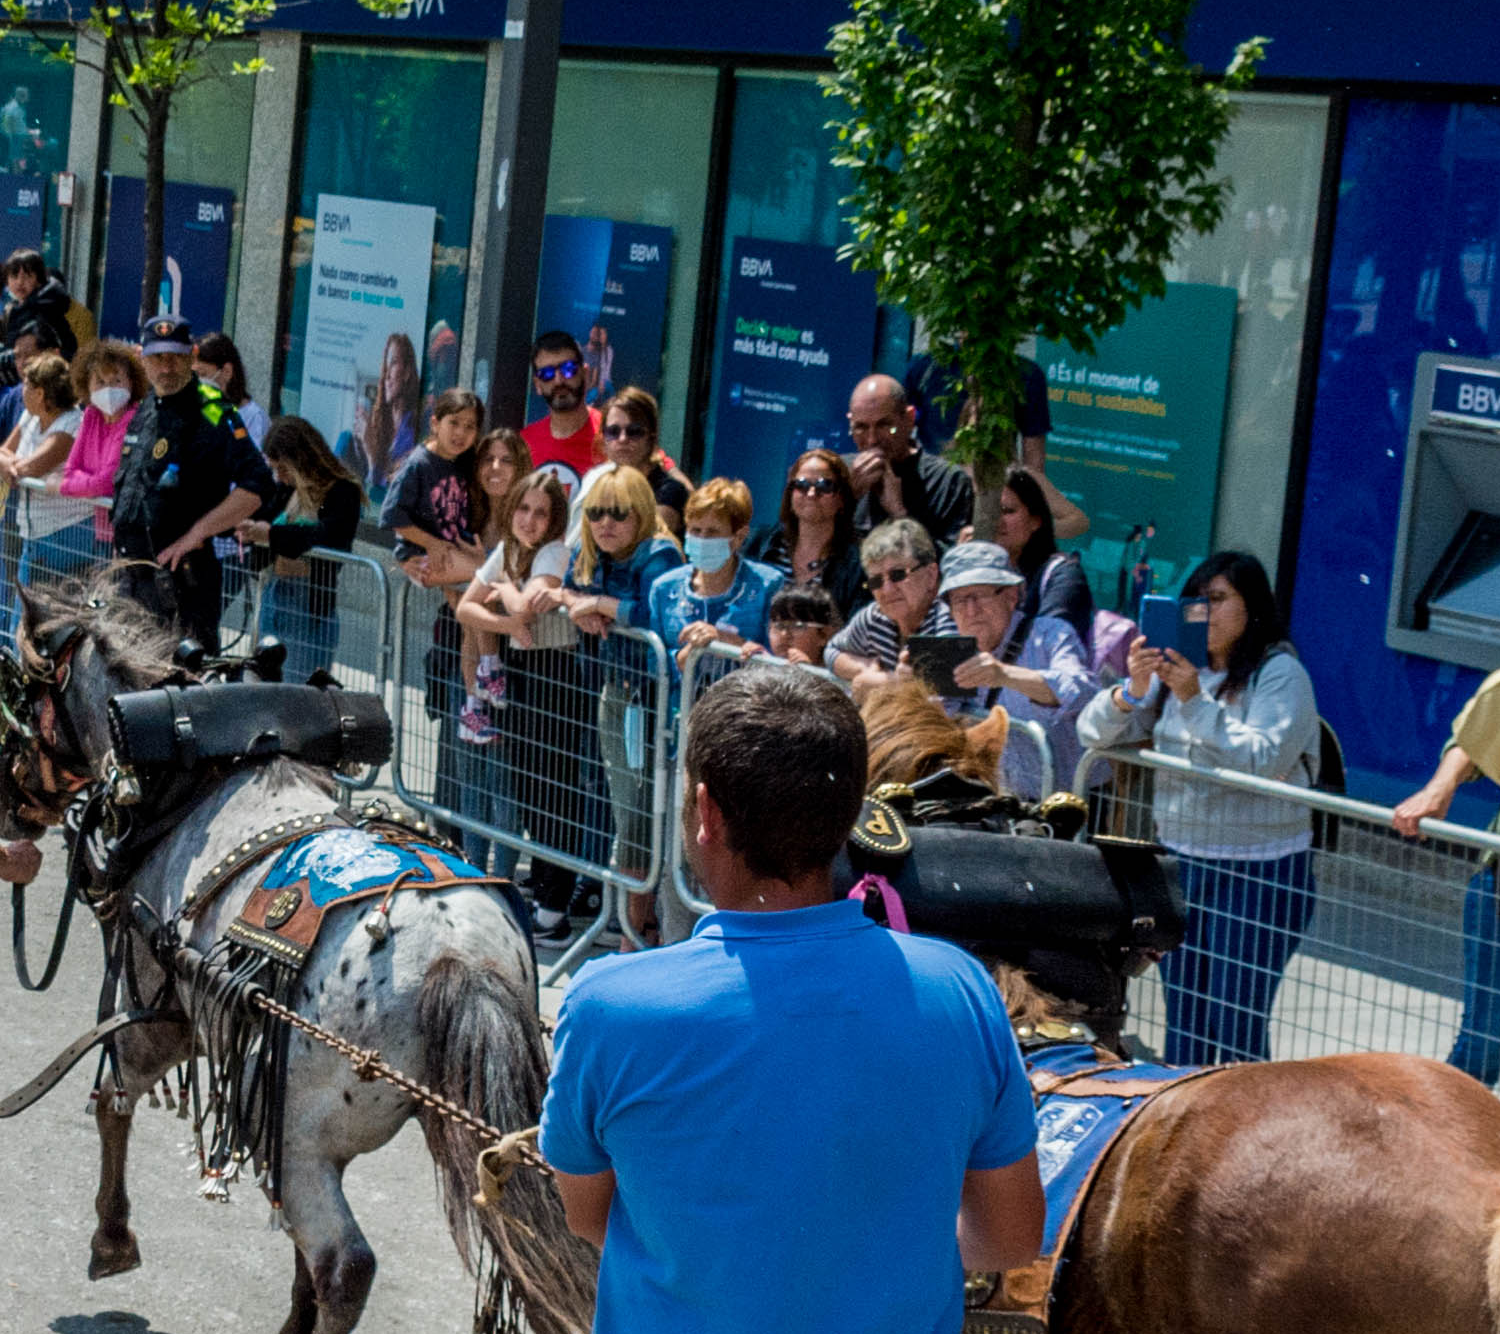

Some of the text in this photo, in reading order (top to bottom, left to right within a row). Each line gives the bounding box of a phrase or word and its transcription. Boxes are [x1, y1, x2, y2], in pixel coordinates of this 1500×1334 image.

[17, 189, 40, 208] BBVA
[198, 202, 225, 222] BBVA
[322, 212, 352, 233] BBVA
[629, 243, 660, 263] BBVA
[740, 256, 773, 278] BBVA
[733, 337, 829, 367] más fácil con ayuda
[1074, 366, 1087, 384] el
[1088, 371, 1141, 393] moment
[1142, 375, 1160, 396] de
